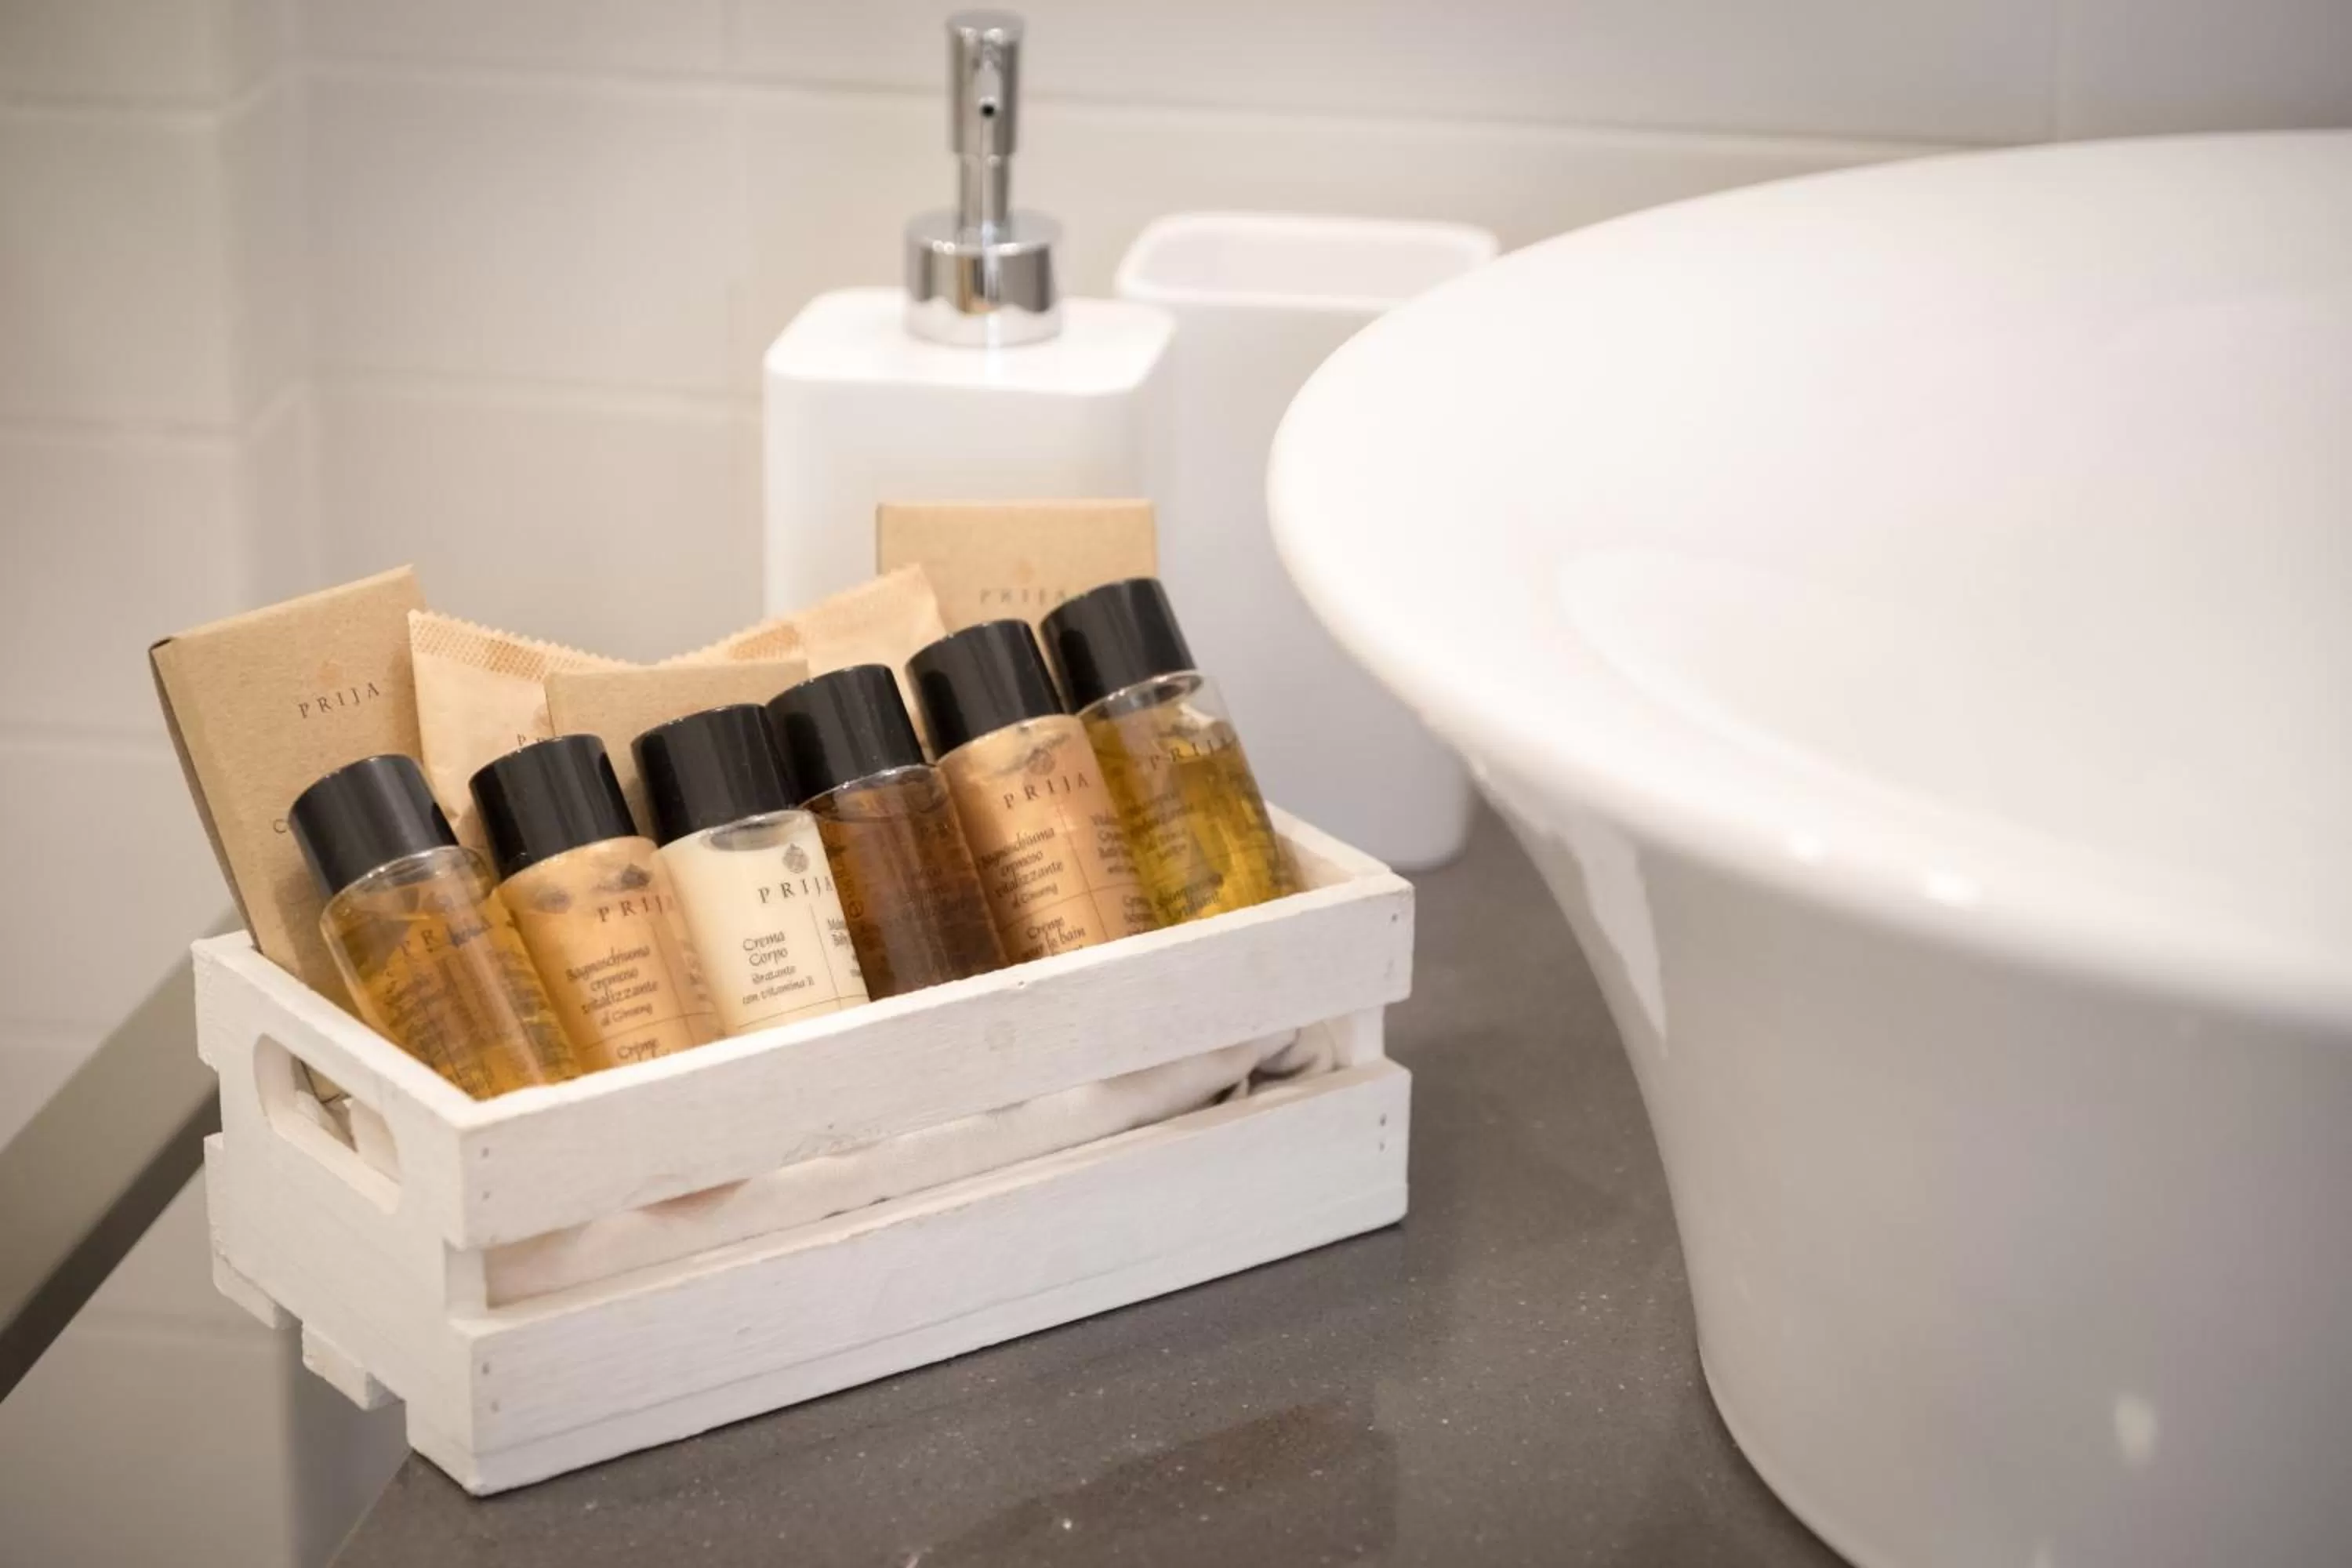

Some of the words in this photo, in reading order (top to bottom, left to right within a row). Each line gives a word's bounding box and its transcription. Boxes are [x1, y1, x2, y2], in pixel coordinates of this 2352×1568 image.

[297, 681, 381, 719] PRIJA
[1002, 771, 1090, 810] PRIJA
[758, 876, 834, 904] PRIJA
[742, 931, 786, 951] Crema
[749, 947, 789, 967] Corpo
